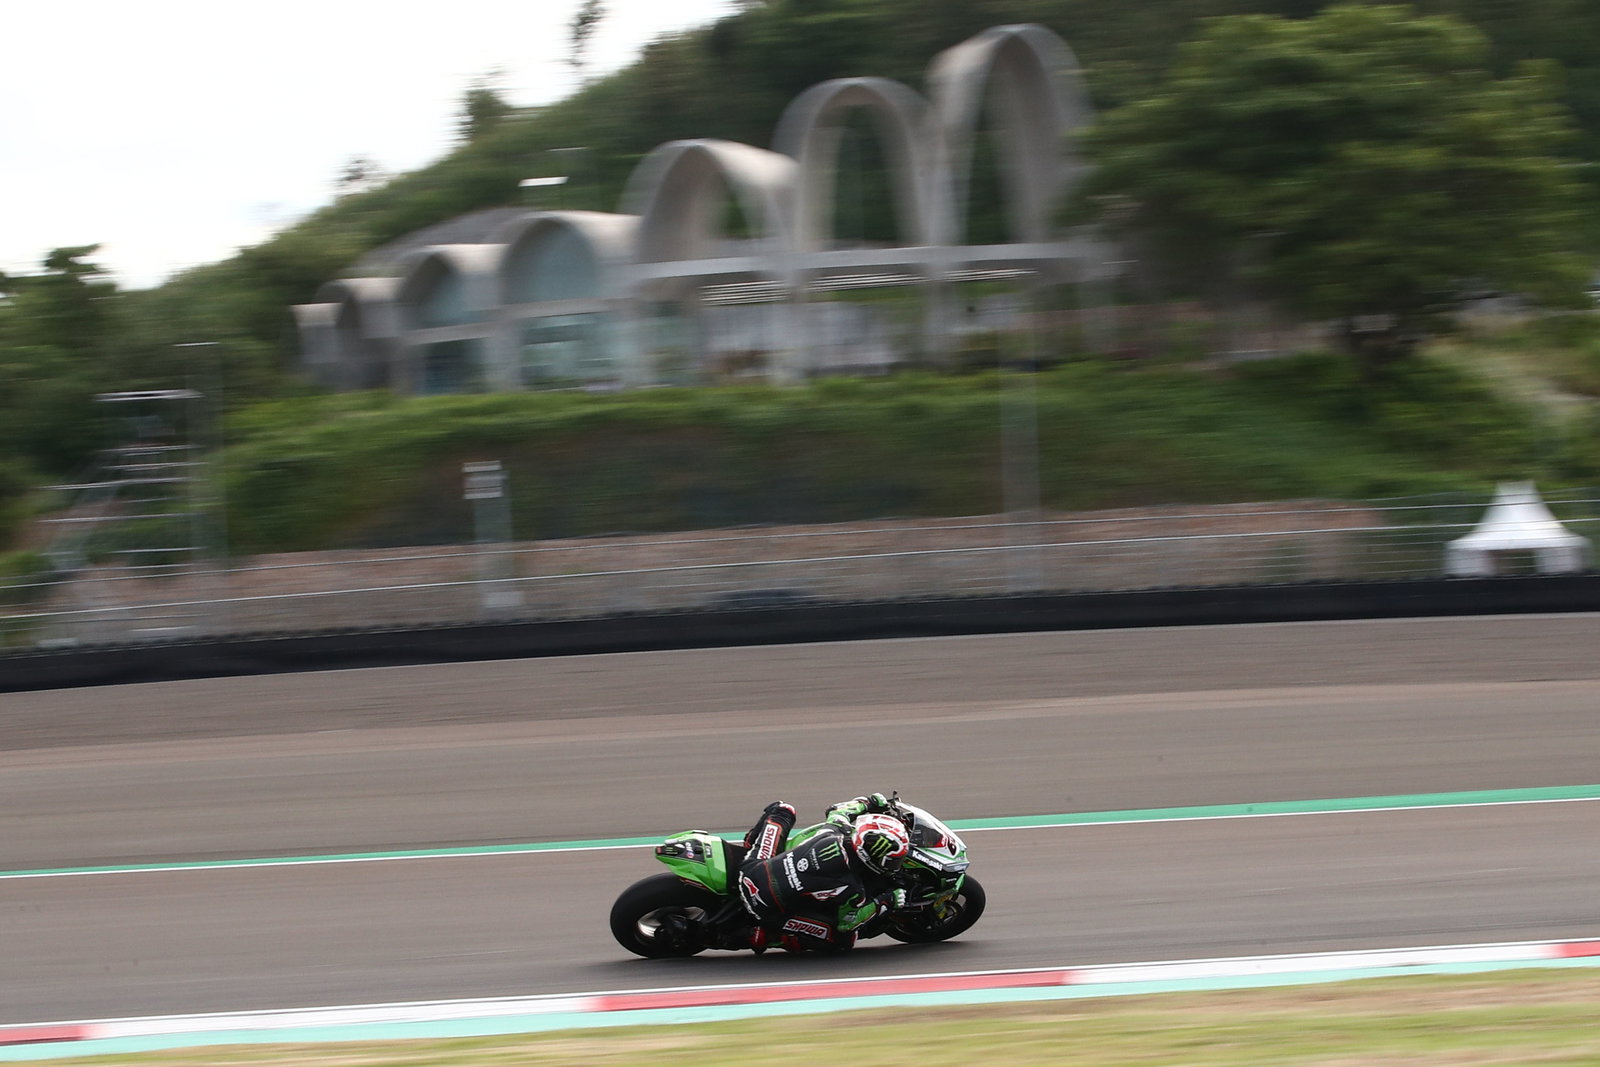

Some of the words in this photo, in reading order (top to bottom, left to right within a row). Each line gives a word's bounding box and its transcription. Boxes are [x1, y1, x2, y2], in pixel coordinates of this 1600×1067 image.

[759, 827, 775, 860] SHOWA
[786, 851, 804, 891] Kawasaki
[912, 850, 943, 871] Kawasaki
[786, 920, 826, 937] SHOWA
